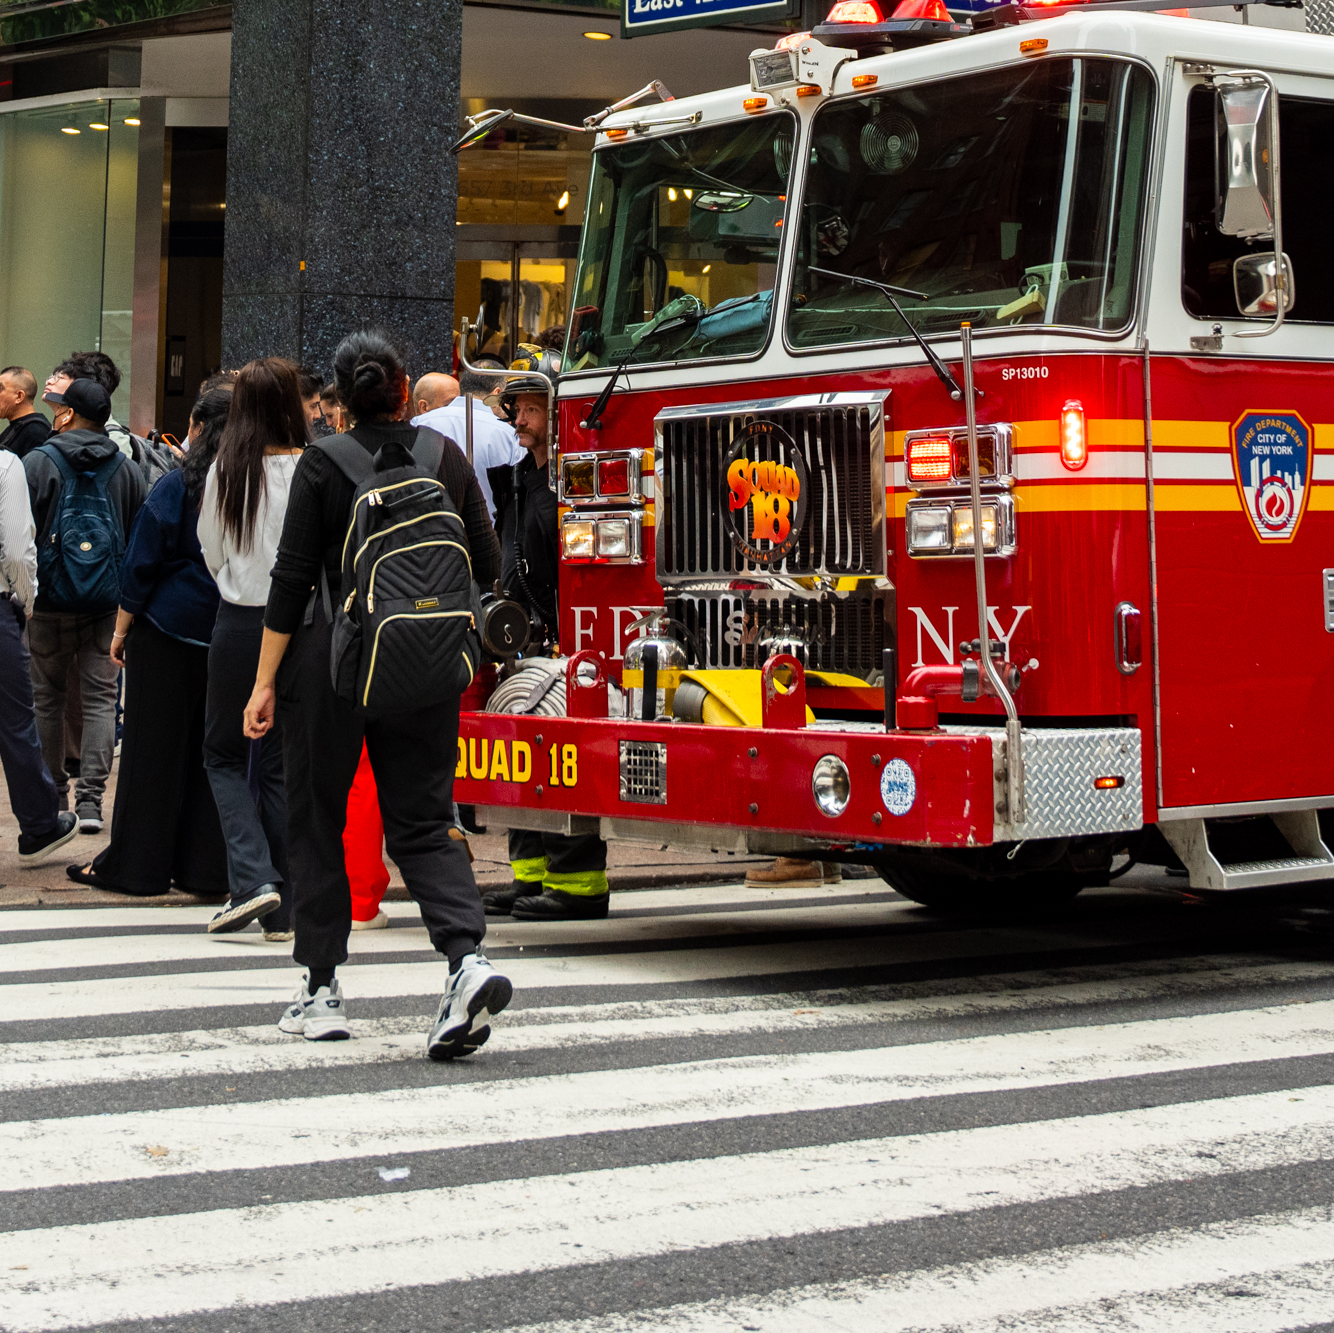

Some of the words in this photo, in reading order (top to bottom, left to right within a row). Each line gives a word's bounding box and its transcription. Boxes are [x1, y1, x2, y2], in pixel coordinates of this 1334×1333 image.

[1002, 366, 1049, 380] SP13010
[749, 425, 773, 435] FDNY
[1242, 427, 1255, 449] FIRE
[1256, 419, 1303, 447] DEPARTMENT
[1257, 434, 1274, 443] CITY
[1276, 434, 1287, 443] OF
[1252, 446, 1270, 455] NEW
[1272, 446, 1293, 455] YORK
[727, 458, 800, 512] SQUAD
[751, 491, 791, 544] 18
[737, 540, 792, 562] MANHATTAN
[455, 736, 532, 783] QUAD
[549, 743, 577, 786] 18
